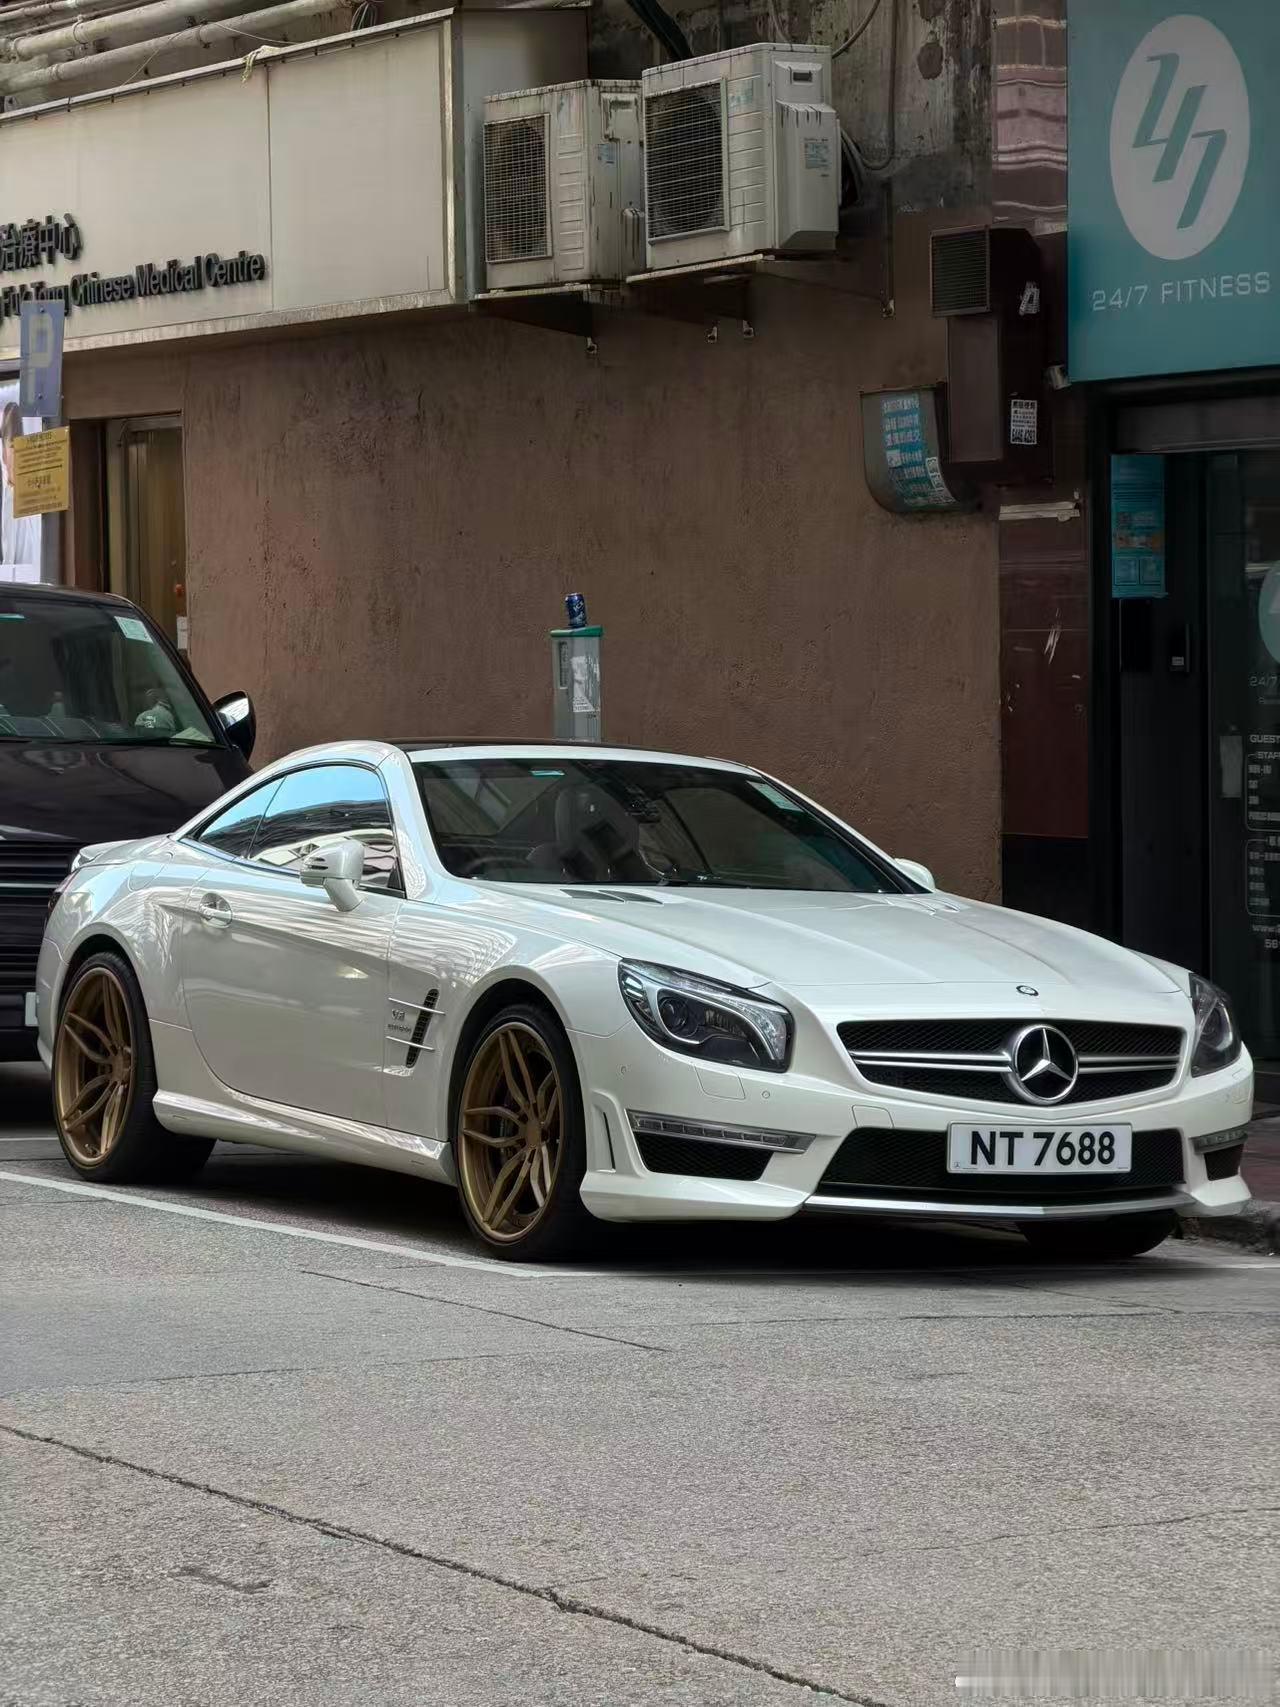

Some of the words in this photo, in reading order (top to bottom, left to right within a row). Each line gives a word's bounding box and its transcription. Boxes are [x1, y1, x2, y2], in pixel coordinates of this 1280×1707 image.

[70, 272, 136, 307] Chinese
[135, 256, 204, 298] Medical
[203, 251, 266, 288] Centre
[1092, 284, 1149, 312] 24/7
[1160, 271, 1272, 305] FITNESS
[970, 1130, 1025, 1166] NT
[1032, 1130, 1116, 1167] 7688
